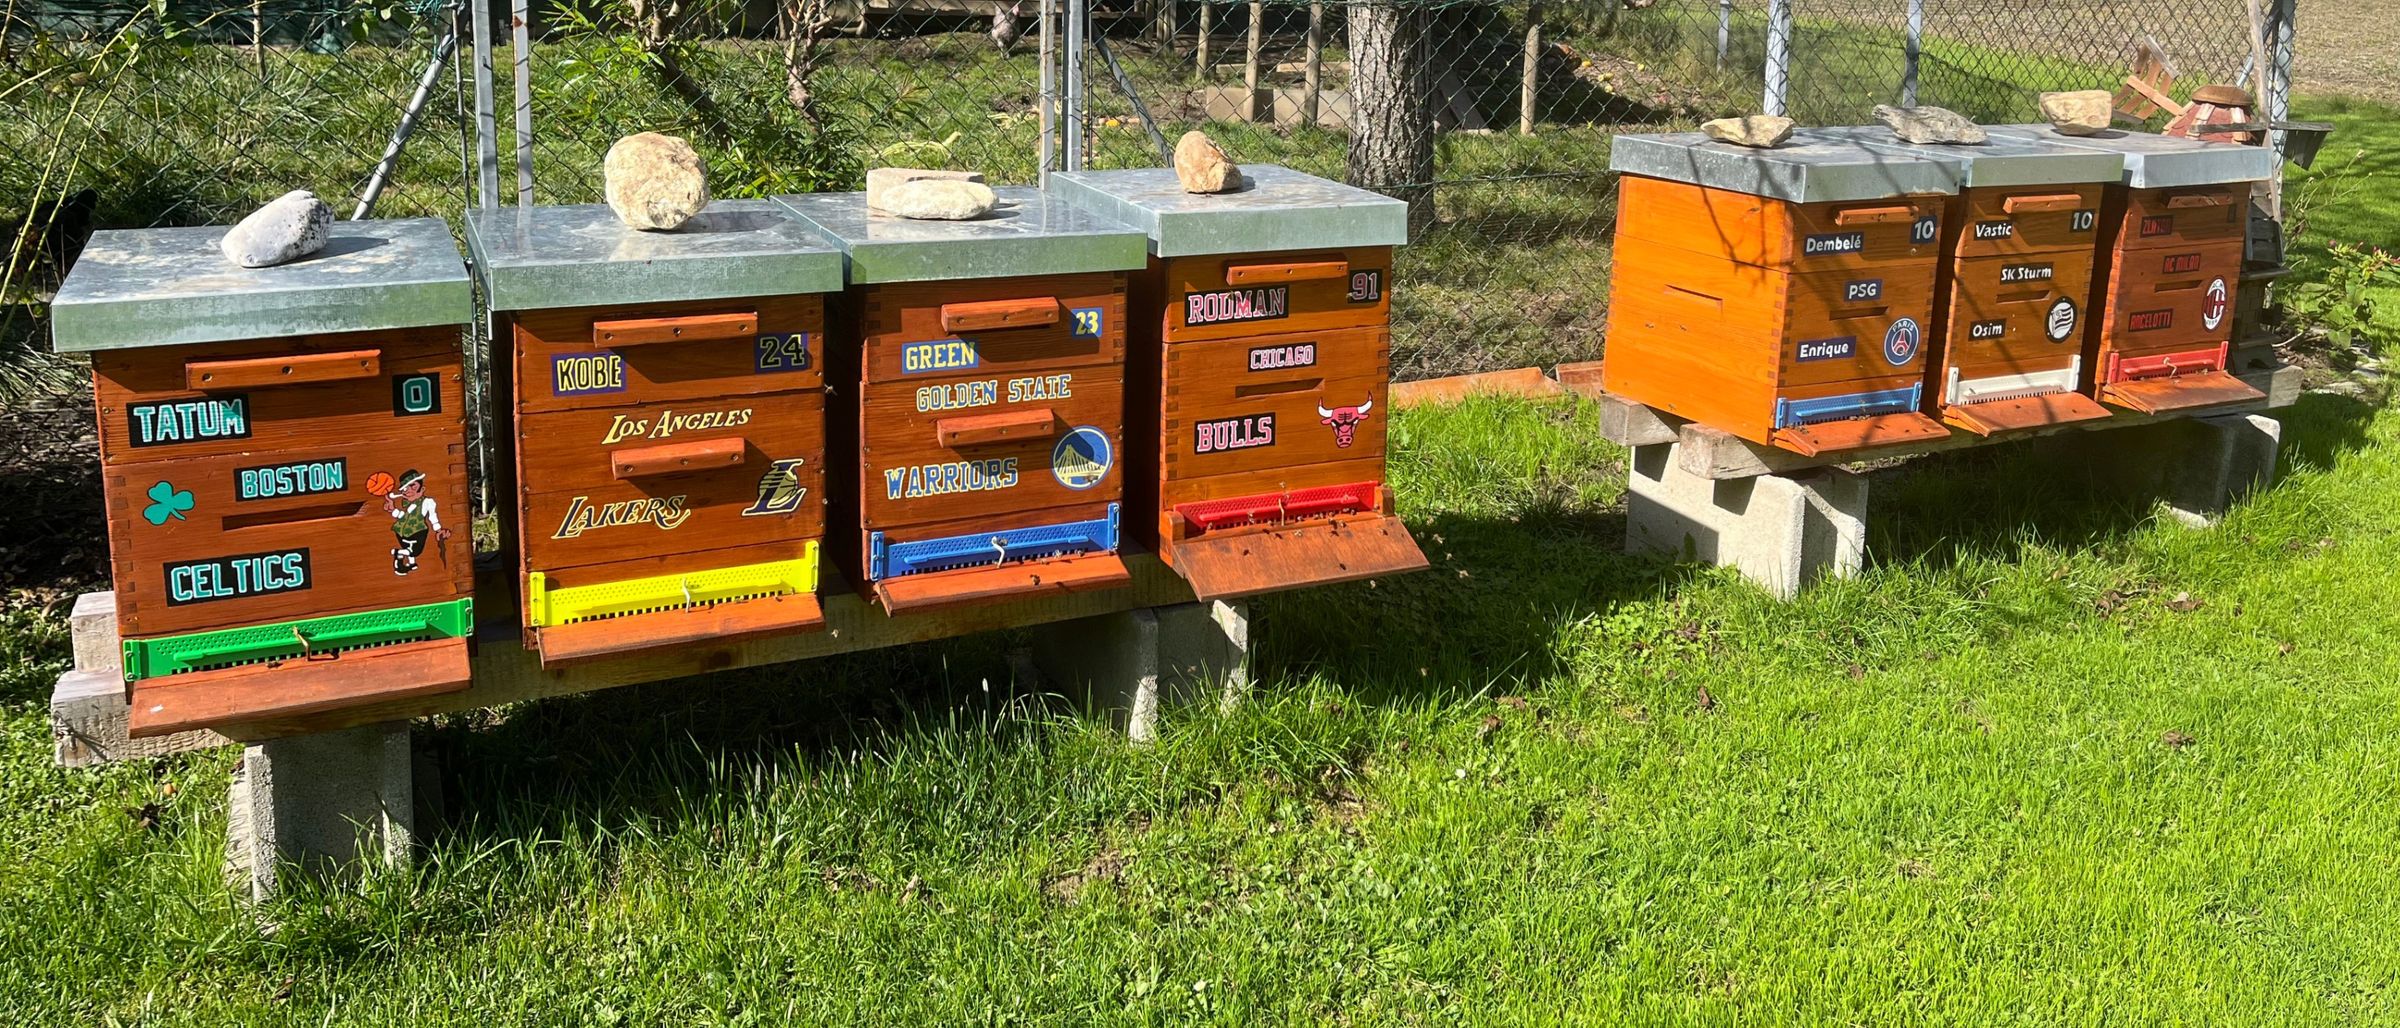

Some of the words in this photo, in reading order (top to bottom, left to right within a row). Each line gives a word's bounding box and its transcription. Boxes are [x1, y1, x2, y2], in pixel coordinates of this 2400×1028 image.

[1914, 220, 1934, 240] 10
[1975, 223, 2012, 238] Vastic
[2073, 211, 2093, 230] 10
[1806, 234, 1862, 253] Dembelé
[2001, 268, 2015, 281] SK
[2017, 266, 2052, 280] Sturm
[2164, 257, 2176, 273] AC
[1352, 272, 1378, 300] 91
[1848, 283, 1877, 300] PSG
[1188, 288, 1286, 324] RODMAN
[1075, 311, 1099, 335] 23
[1892, 320, 1914, 332] PARIS
[1972, 322, 2003, 337] Osim
[759, 334, 805, 369] 24
[905, 341, 976, 371] GREEN
[1250, 345, 1314, 370] CHICAGO
[1800, 342, 1849, 358] Enrique
[556, 355, 622, 391] KOBE
[402, 376, 432, 412] 0
[916, 379, 998, 412] GOLDEN
[1008, 373, 1072, 403] STATE
[133, 398, 246, 443] TATUM
[1196, 416, 1273, 453] BULLS
[241, 461, 343, 498] BOSTON
[884, 458, 1018, 500] WARRIORS
[551, 494, 690, 539] LAKERS
[170, 552, 304, 602] CELTICS
